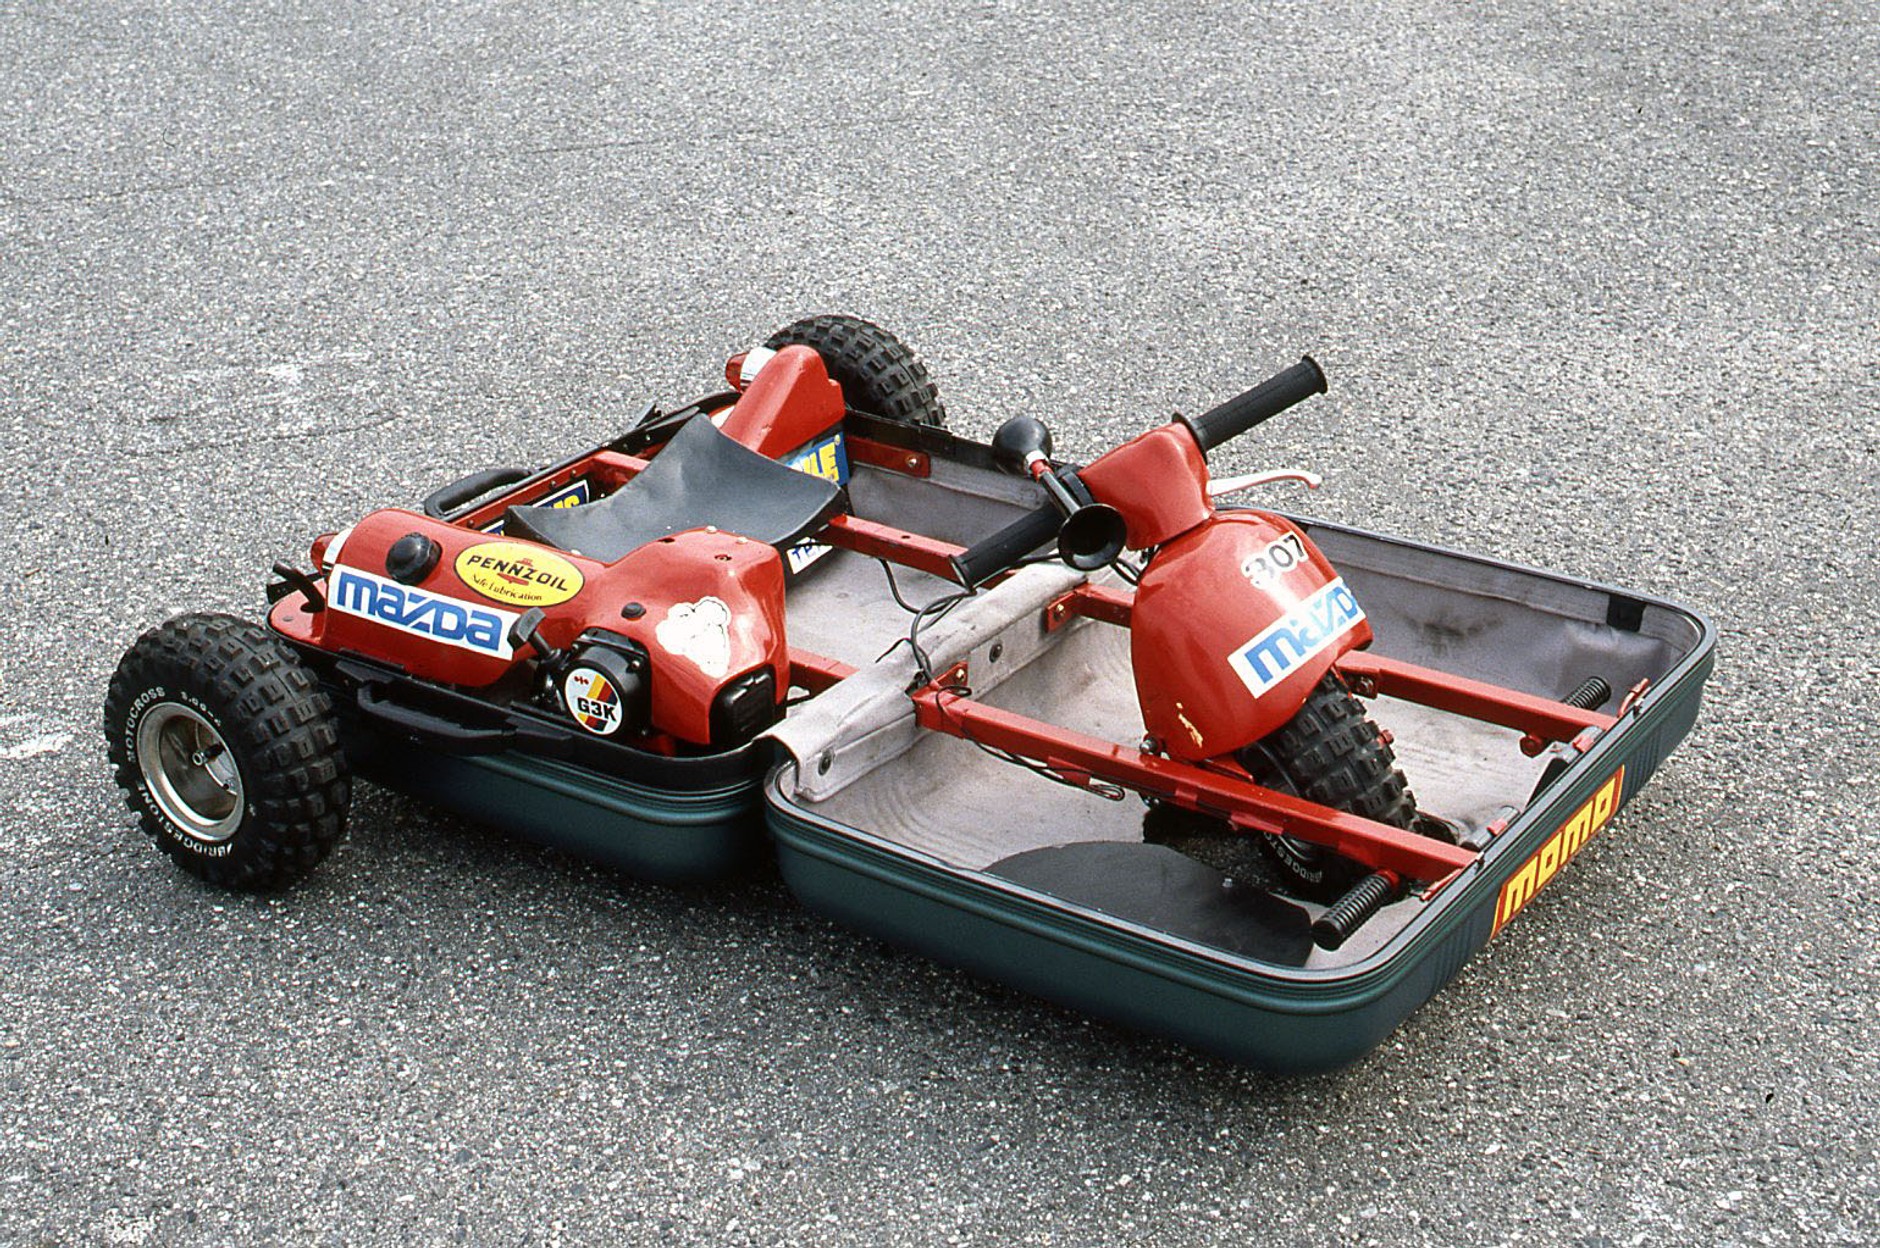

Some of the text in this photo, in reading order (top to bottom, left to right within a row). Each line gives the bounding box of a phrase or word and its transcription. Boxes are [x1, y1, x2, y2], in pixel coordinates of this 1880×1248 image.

[467, 555, 568, 591] PENNZOIL
[488, 584, 542, 601] Lubrication
[126, 686, 166, 763] MOTOCROSS
[577, 697, 617, 722] G3K
[137, 781, 233, 857] BRIDGESTONE
[1263, 831, 1322, 883] BRIDGESTO
